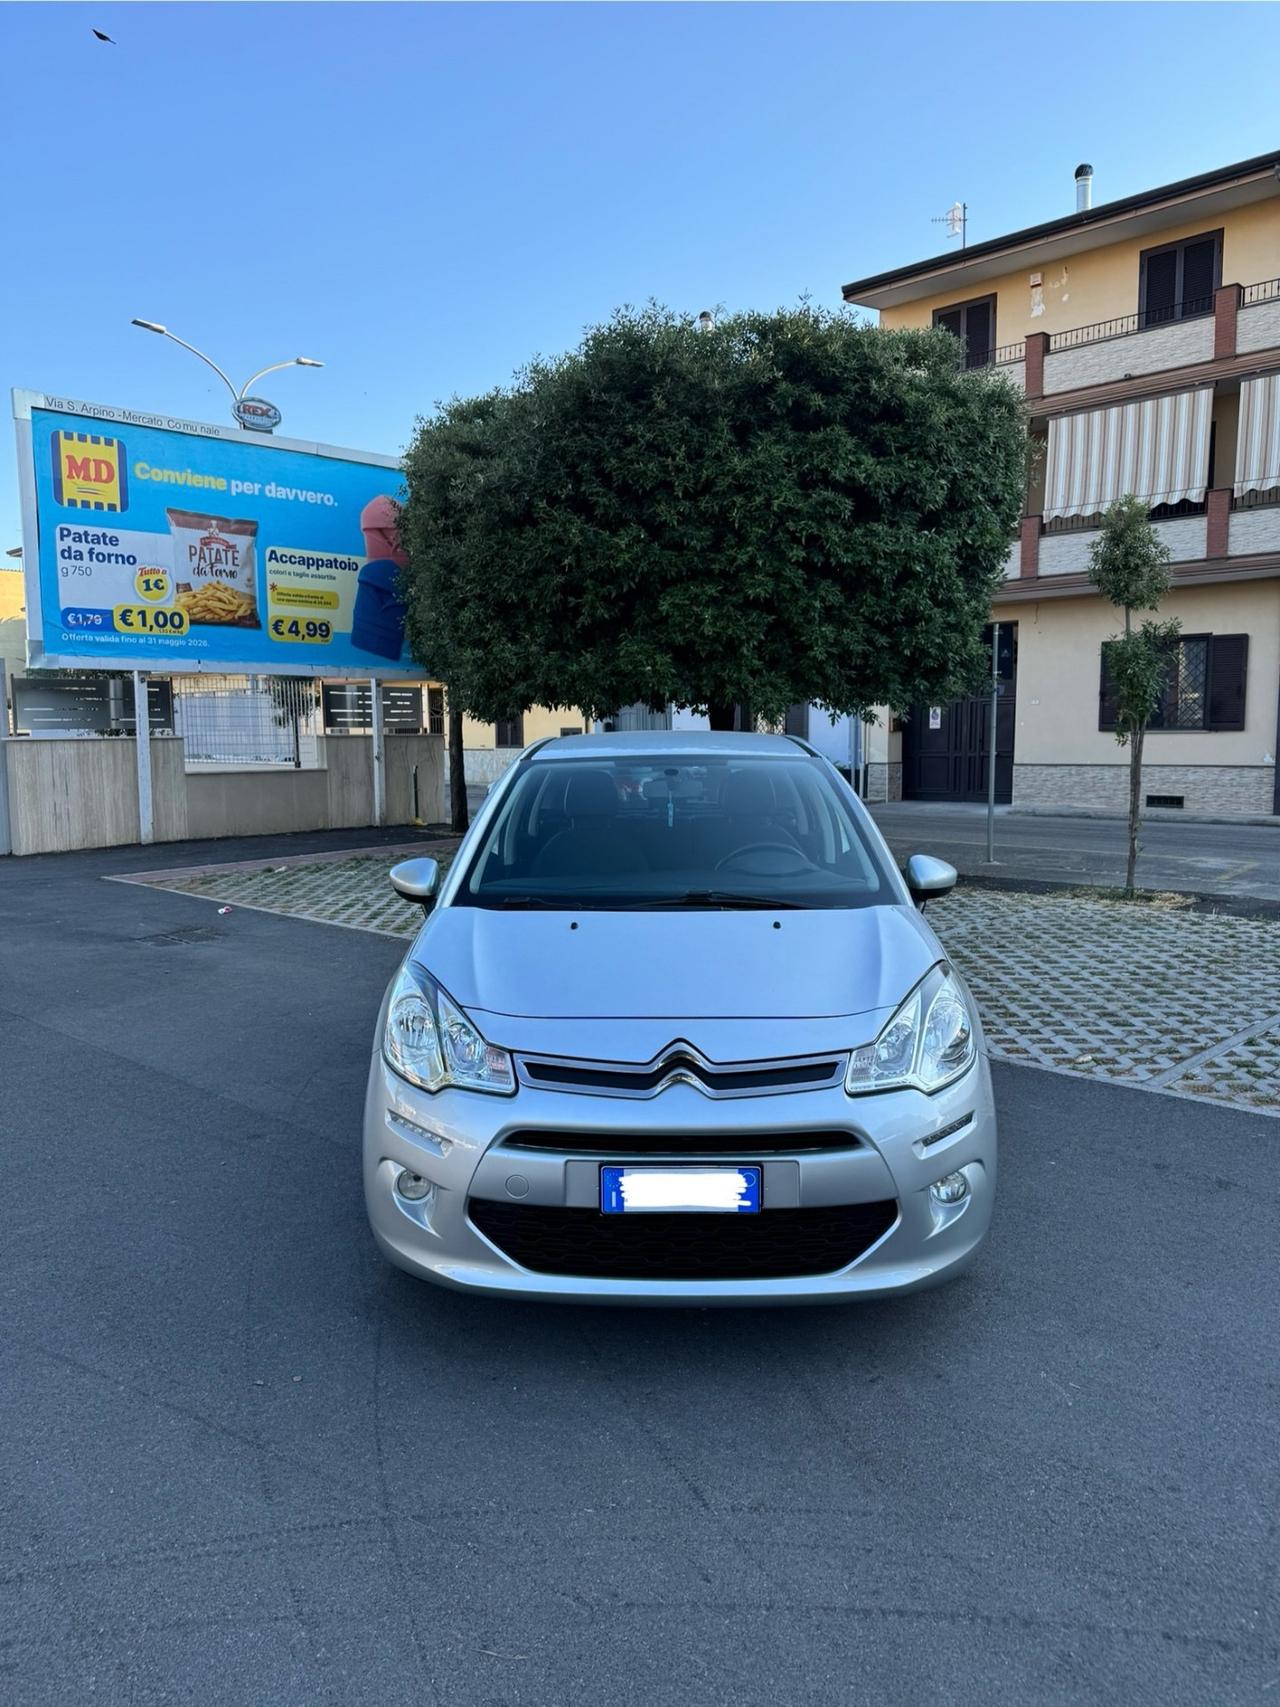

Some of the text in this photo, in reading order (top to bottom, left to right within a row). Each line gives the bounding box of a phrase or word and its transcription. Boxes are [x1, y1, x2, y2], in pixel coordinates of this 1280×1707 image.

[45, 396, 64, 409] Via
[66, 401, 78, 412] S.
[80, 403, 115, 418] Arpino
[65, 454, 115, 484] MD
[134, 461, 339, 507] Conviene per davvero.
[59, 526, 120, 547] Patate
[60, 545, 137, 566] da forno
[188, 545, 240, 567] PATATE
[268, 549, 359, 572] Accappatoio
[138, 567, 160, 577] Tutto
[142, 578, 165, 592] 1€
[61, 632, 94, 641] Offerta
[94, 634, 120, 643] valida
[120, 635, 137, 644] fino
[158, 638, 187, 647] maggio
